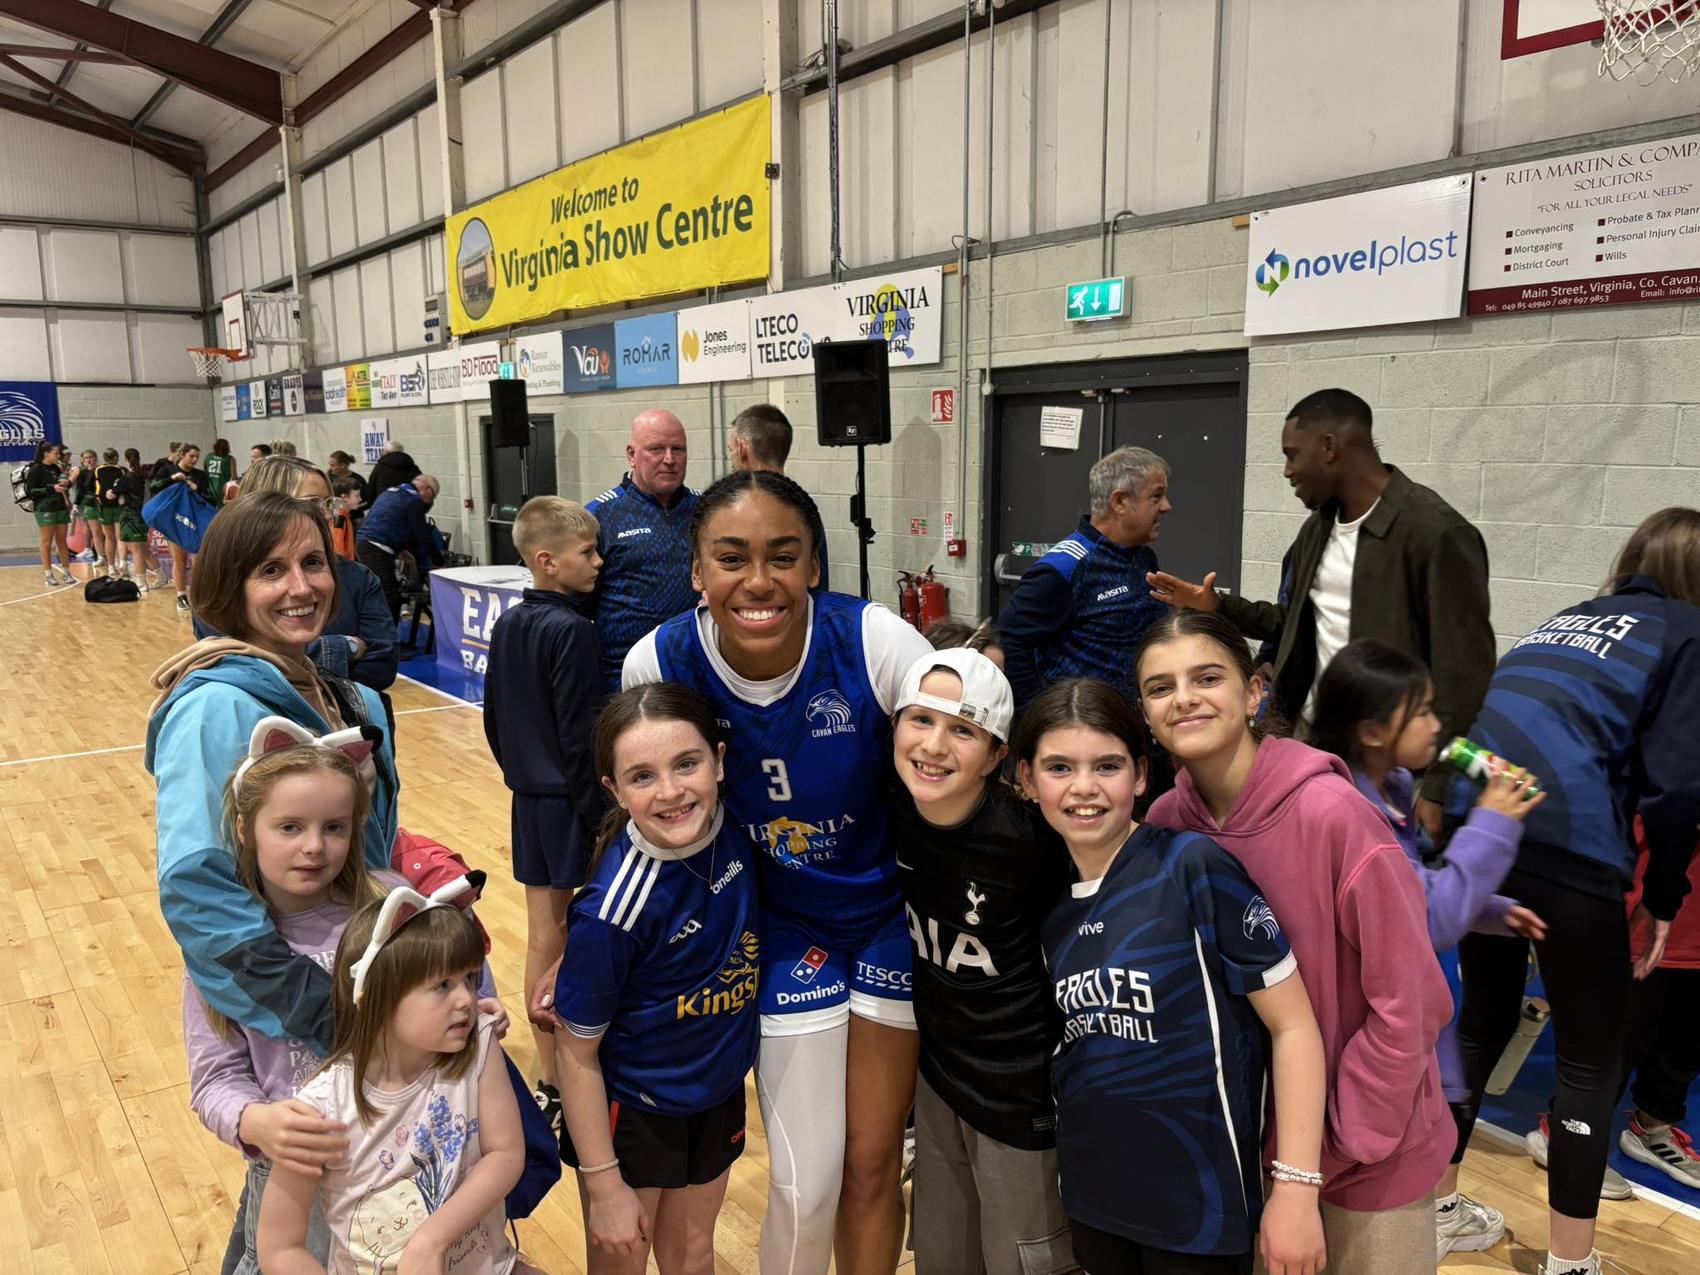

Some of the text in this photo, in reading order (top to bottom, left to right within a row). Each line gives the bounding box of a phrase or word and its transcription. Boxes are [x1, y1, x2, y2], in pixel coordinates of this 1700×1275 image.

[1506, 169, 1543, 186] RITA
[1546, 155, 1615, 180] MARTIN
[1618, 153, 1633, 168] &
[1574, 169, 1653, 191] SOLICITORS
[551, 176, 640, 225] Welcome to
[1563, 199, 1583, 210] ALL
[1584, 194, 1613, 207] YOUR
[1616, 190, 1650, 203] LEGAL
[1607, 212, 1644, 226] Probate
[1646, 211, 1653, 220] &
[1656, 209, 1672, 219] Tax
[1514, 222, 1575, 238] Conveyancing
[1606, 228, 1647, 244] Personal
[1649, 225, 1677, 240] Injury
[500, 194, 754, 292] Virginia Show Centre
[1513, 240, 1564, 255] Mortgaging
[1294, 230, 1459, 280] novelplast
[1513, 257, 1569, 272] District Court
[1605, 250, 1628, 261] Wills
[1521, 288, 1549, 300] Main
[1551, 284, 1588, 298] Street,
[1589, 278, 1637, 295] Virginia,
[1639, 276, 1659, 289] Co.
[1640, 289, 1666, 299] Email:
[847, 286, 930, 318] VIRGINIA
[1485, 303, 1498, 313] Tel:
[1516, 301, 1527, 311] 85
[755, 313, 799, 339] LTECO
[859, 316, 916, 337] SHOPPING
[703, 329, 728, 344] Jones
[703, 341, 747, 357] Engineering
[757, 336, 832, 364] TELECO
[208, 460, 222, 474] 21
[811, 724, 856, 738] CAVAN EAGLES
[761, 758, 793, 802] 3
[776, 980, 846, 1006] Domino's
[1055, 967, 1155, 1014] EAGLES
